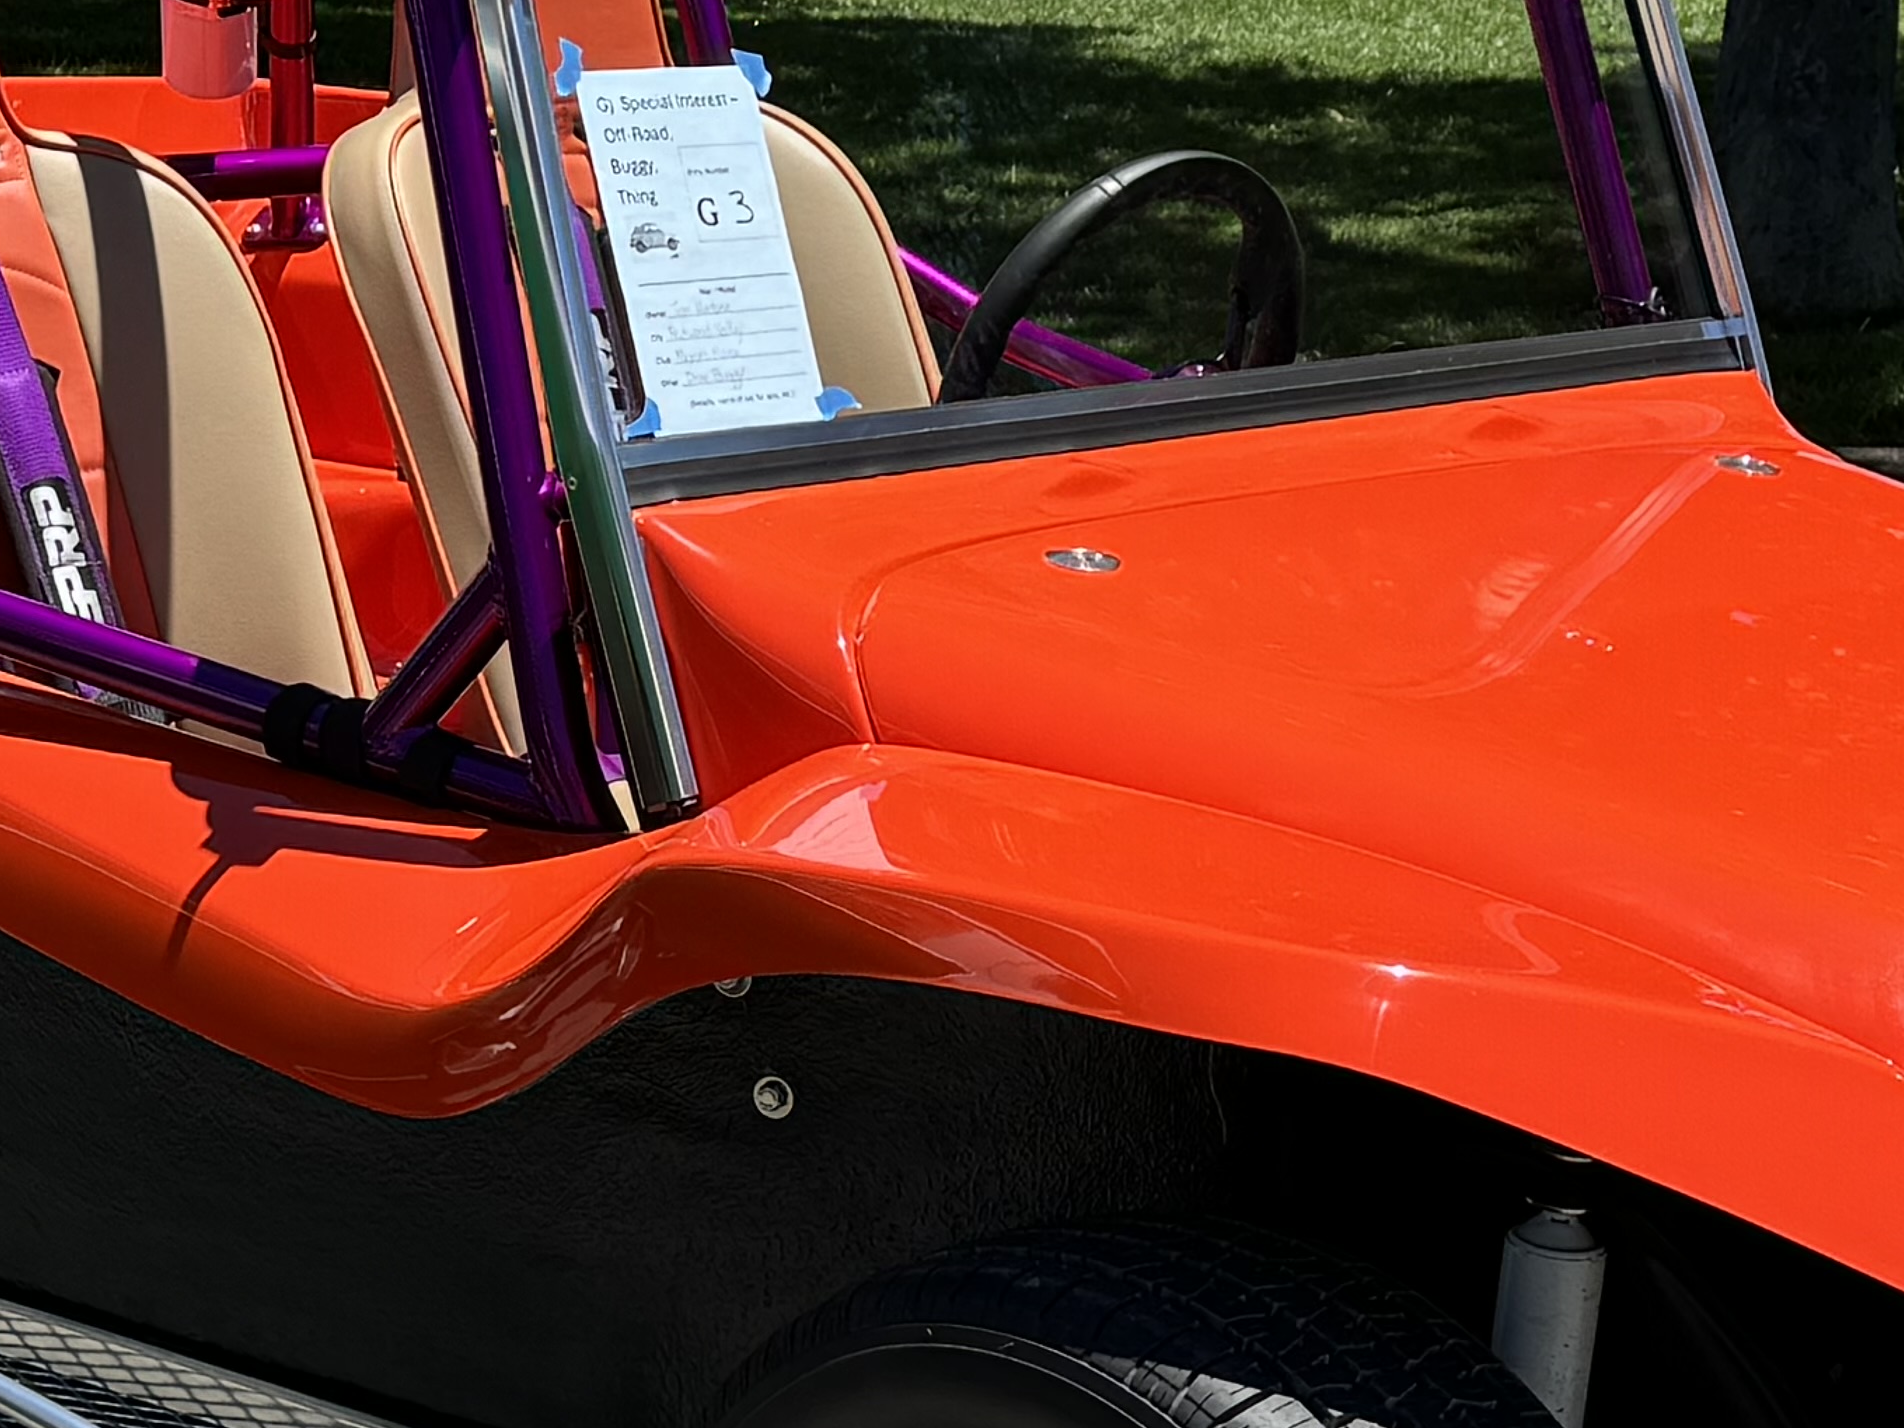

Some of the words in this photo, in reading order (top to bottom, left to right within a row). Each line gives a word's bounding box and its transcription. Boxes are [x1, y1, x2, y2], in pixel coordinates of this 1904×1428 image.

[620, 94, 673, 114] Special
[675, 93, 728, 109] Interest
[617, 189, 659, 207] Thing
[697, 197, 719, 227] G
[728, 190, 755, 225] 3
